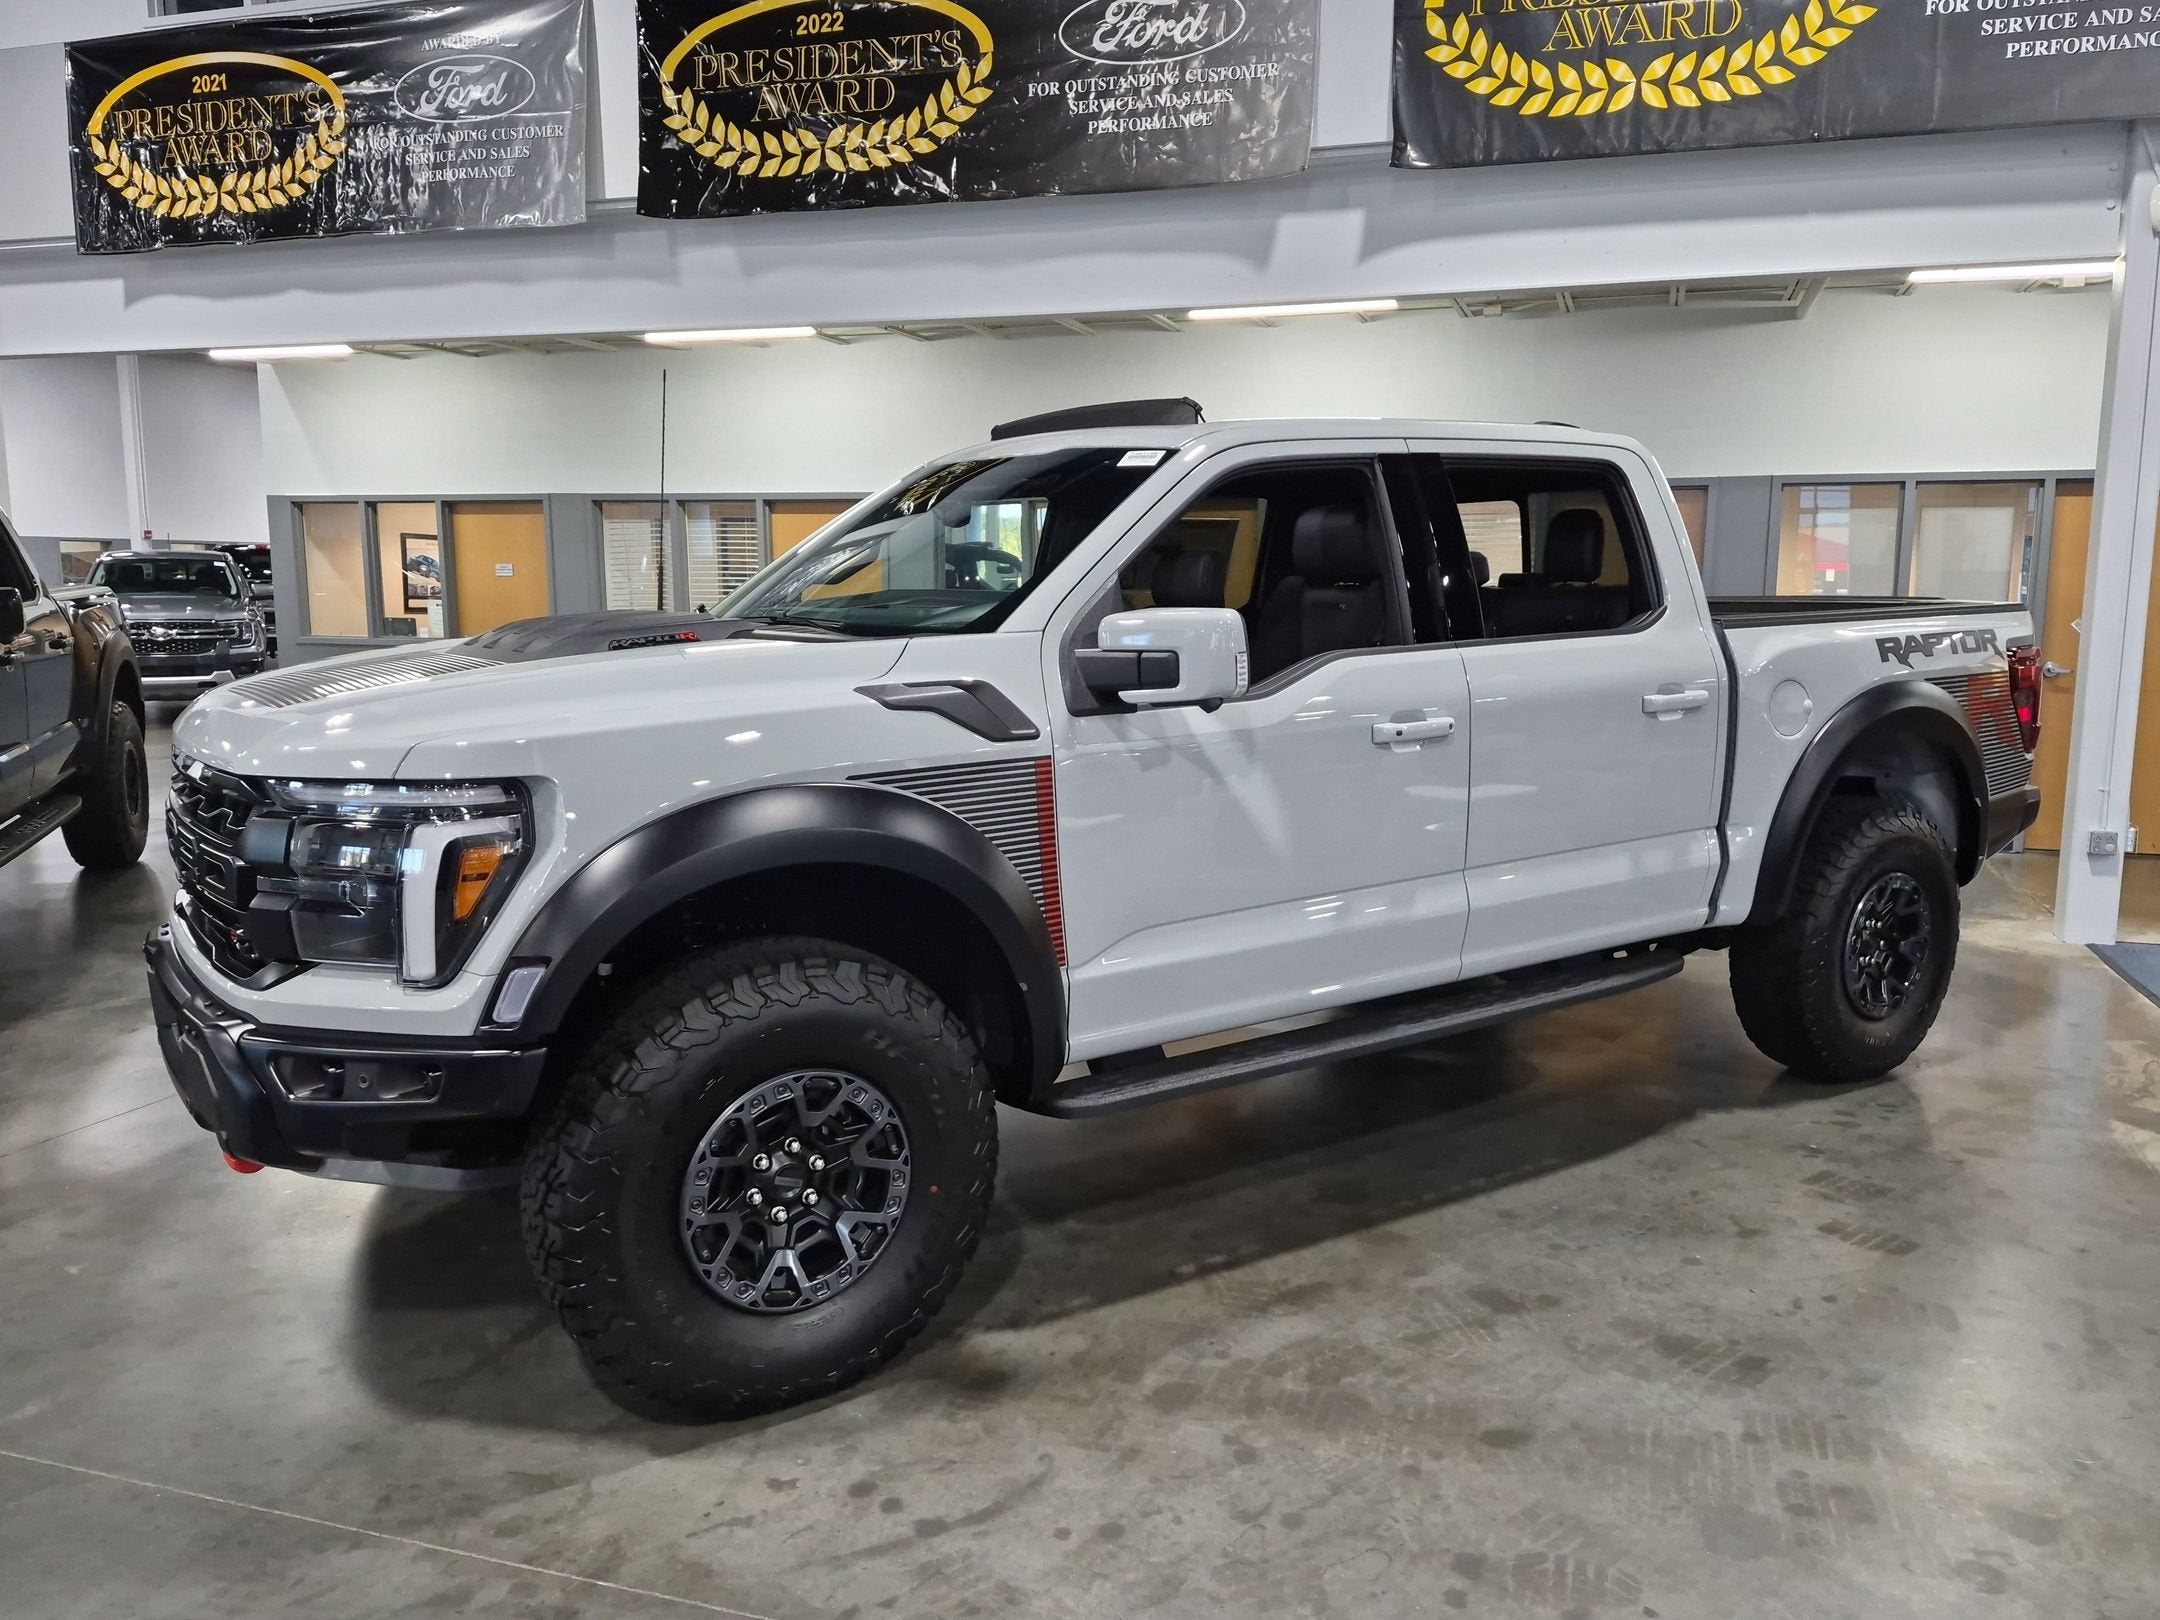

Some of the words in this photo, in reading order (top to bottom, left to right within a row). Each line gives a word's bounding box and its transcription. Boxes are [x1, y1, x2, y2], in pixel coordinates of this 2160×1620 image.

[796, 11, 844, 35] 2022
[1925, 0, 1970, 16] FOR
[1981, 12, 2079, 36] SERVICE
[2084, 8, 2134, 28] AND
[1091, 0, 1209, 53] Ford
[1542, 0, 1743, 52] AWARD
[692, 30, 964, 90] PRESIDENT'S
[192, 73, 228, 94] 2021
[415, 64, 509, 113] Ford
[1028, 82, 1060, 98] FOR
[1065, 70, 1180, 95] OUTSTANDING
[1185, 62, 1279, 84] CUSTOMER
[113, 88, 321, 142] PRESIDENT'S
[751, 76, 895, 122] AWARD
[1069, 96, 1138, 116] SERVICE
[1144, 93, 1177, 109] AND
[1182, 88, 1234, 105] SALES
[401, 130, 488, 147] OUTSTANDING
[492, 124, 564, 141] CUSTOMER
[1087, 112, 1213, 134] PERFORMANCE
[161, 130, 273, 169] AWARD
[405, 149, 456, 166] SERVICE
[460, 148, 487, 161] AND
[490, 145, 530, 159] SALES
[421, 166, 516, 183] PERFORMANCE
[1875, 629, 2005, 669] RAPTOR
